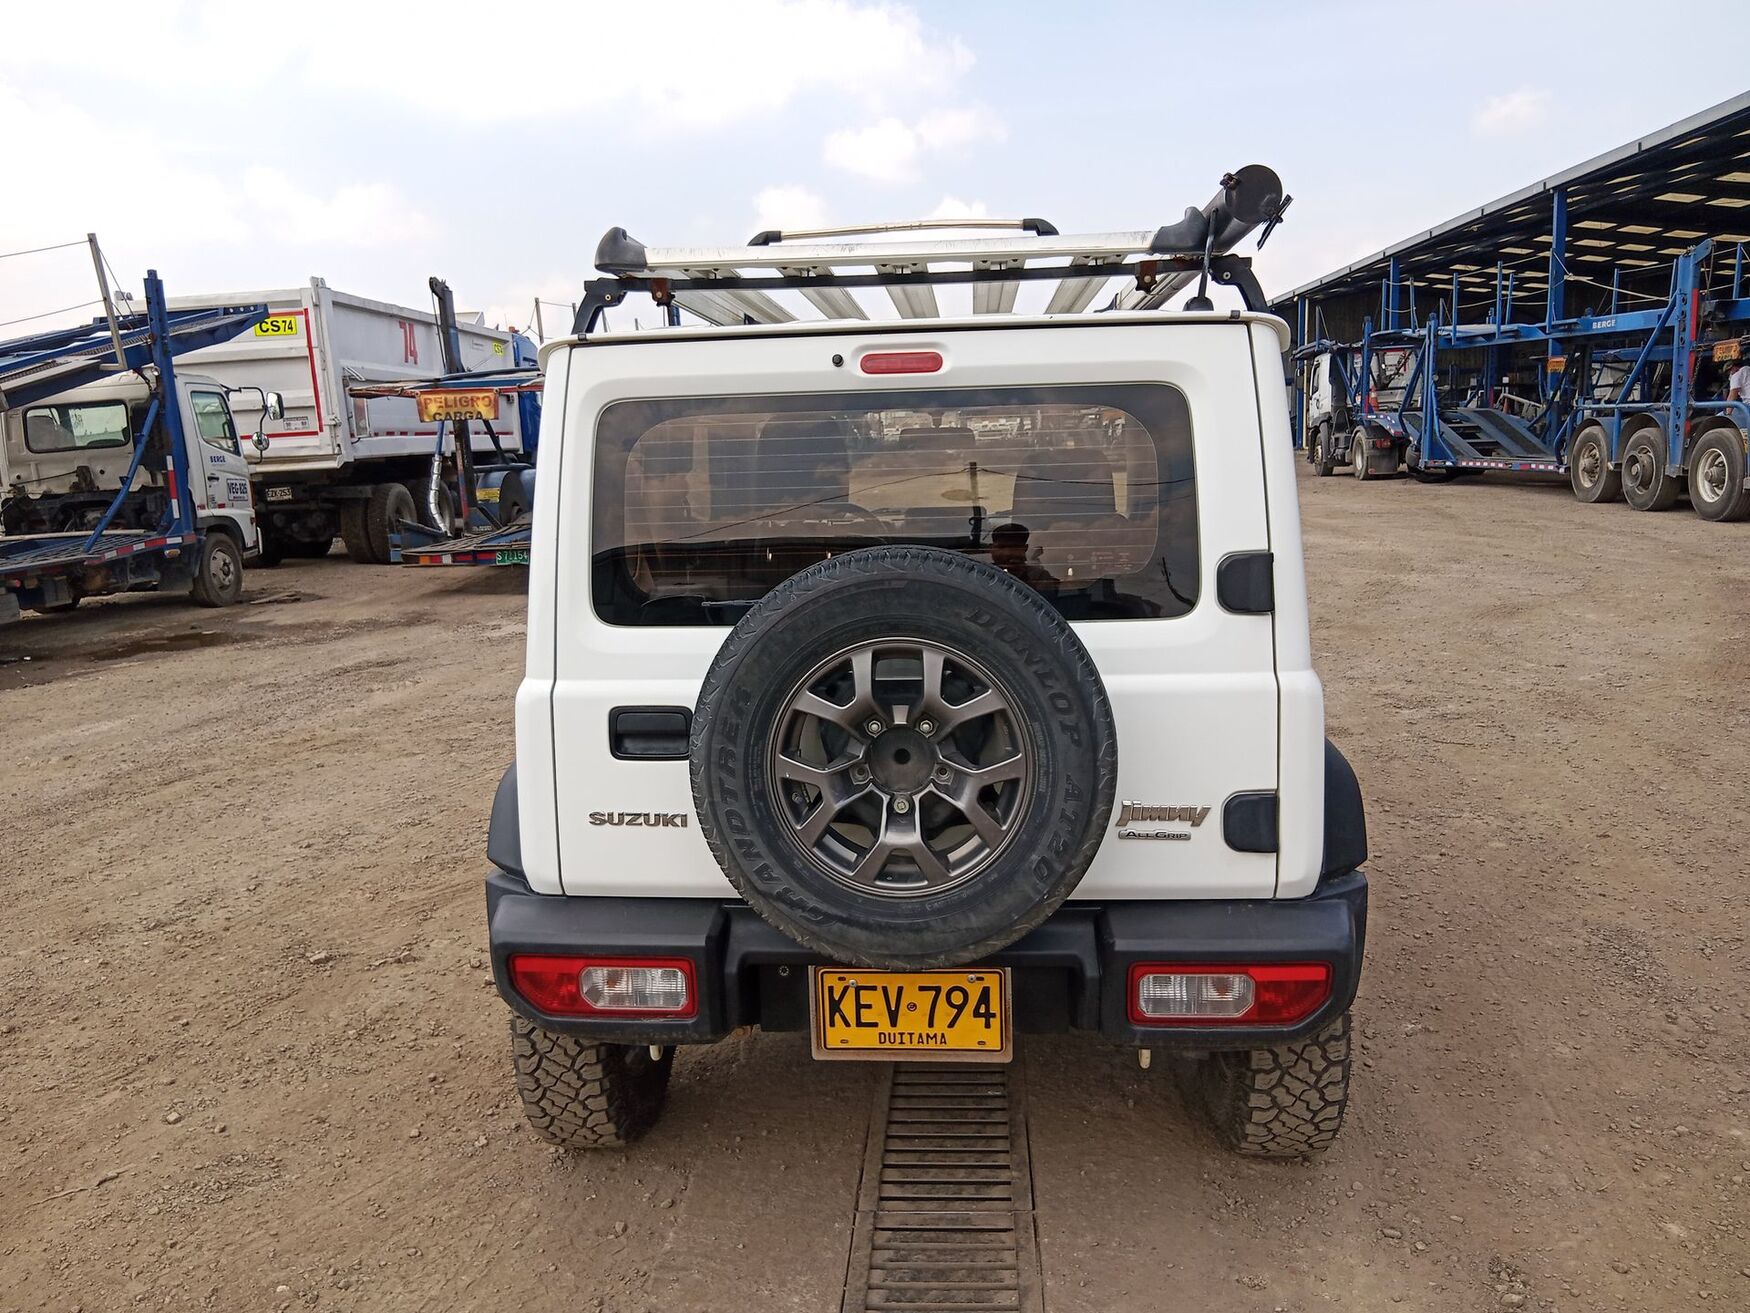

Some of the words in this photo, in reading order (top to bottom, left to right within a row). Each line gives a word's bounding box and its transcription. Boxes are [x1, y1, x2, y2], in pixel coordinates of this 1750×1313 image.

[1592, 319, 1616, 329] BERGE
[399, 320, 418, 365] 74
[423, 394, 492, 410] PELIGRO
[963, 606, 1082, 748] DUNLOP
[589, 811, 688, 828] SUZUKI
[878, 1032, 948, 1045] DUITAMA
